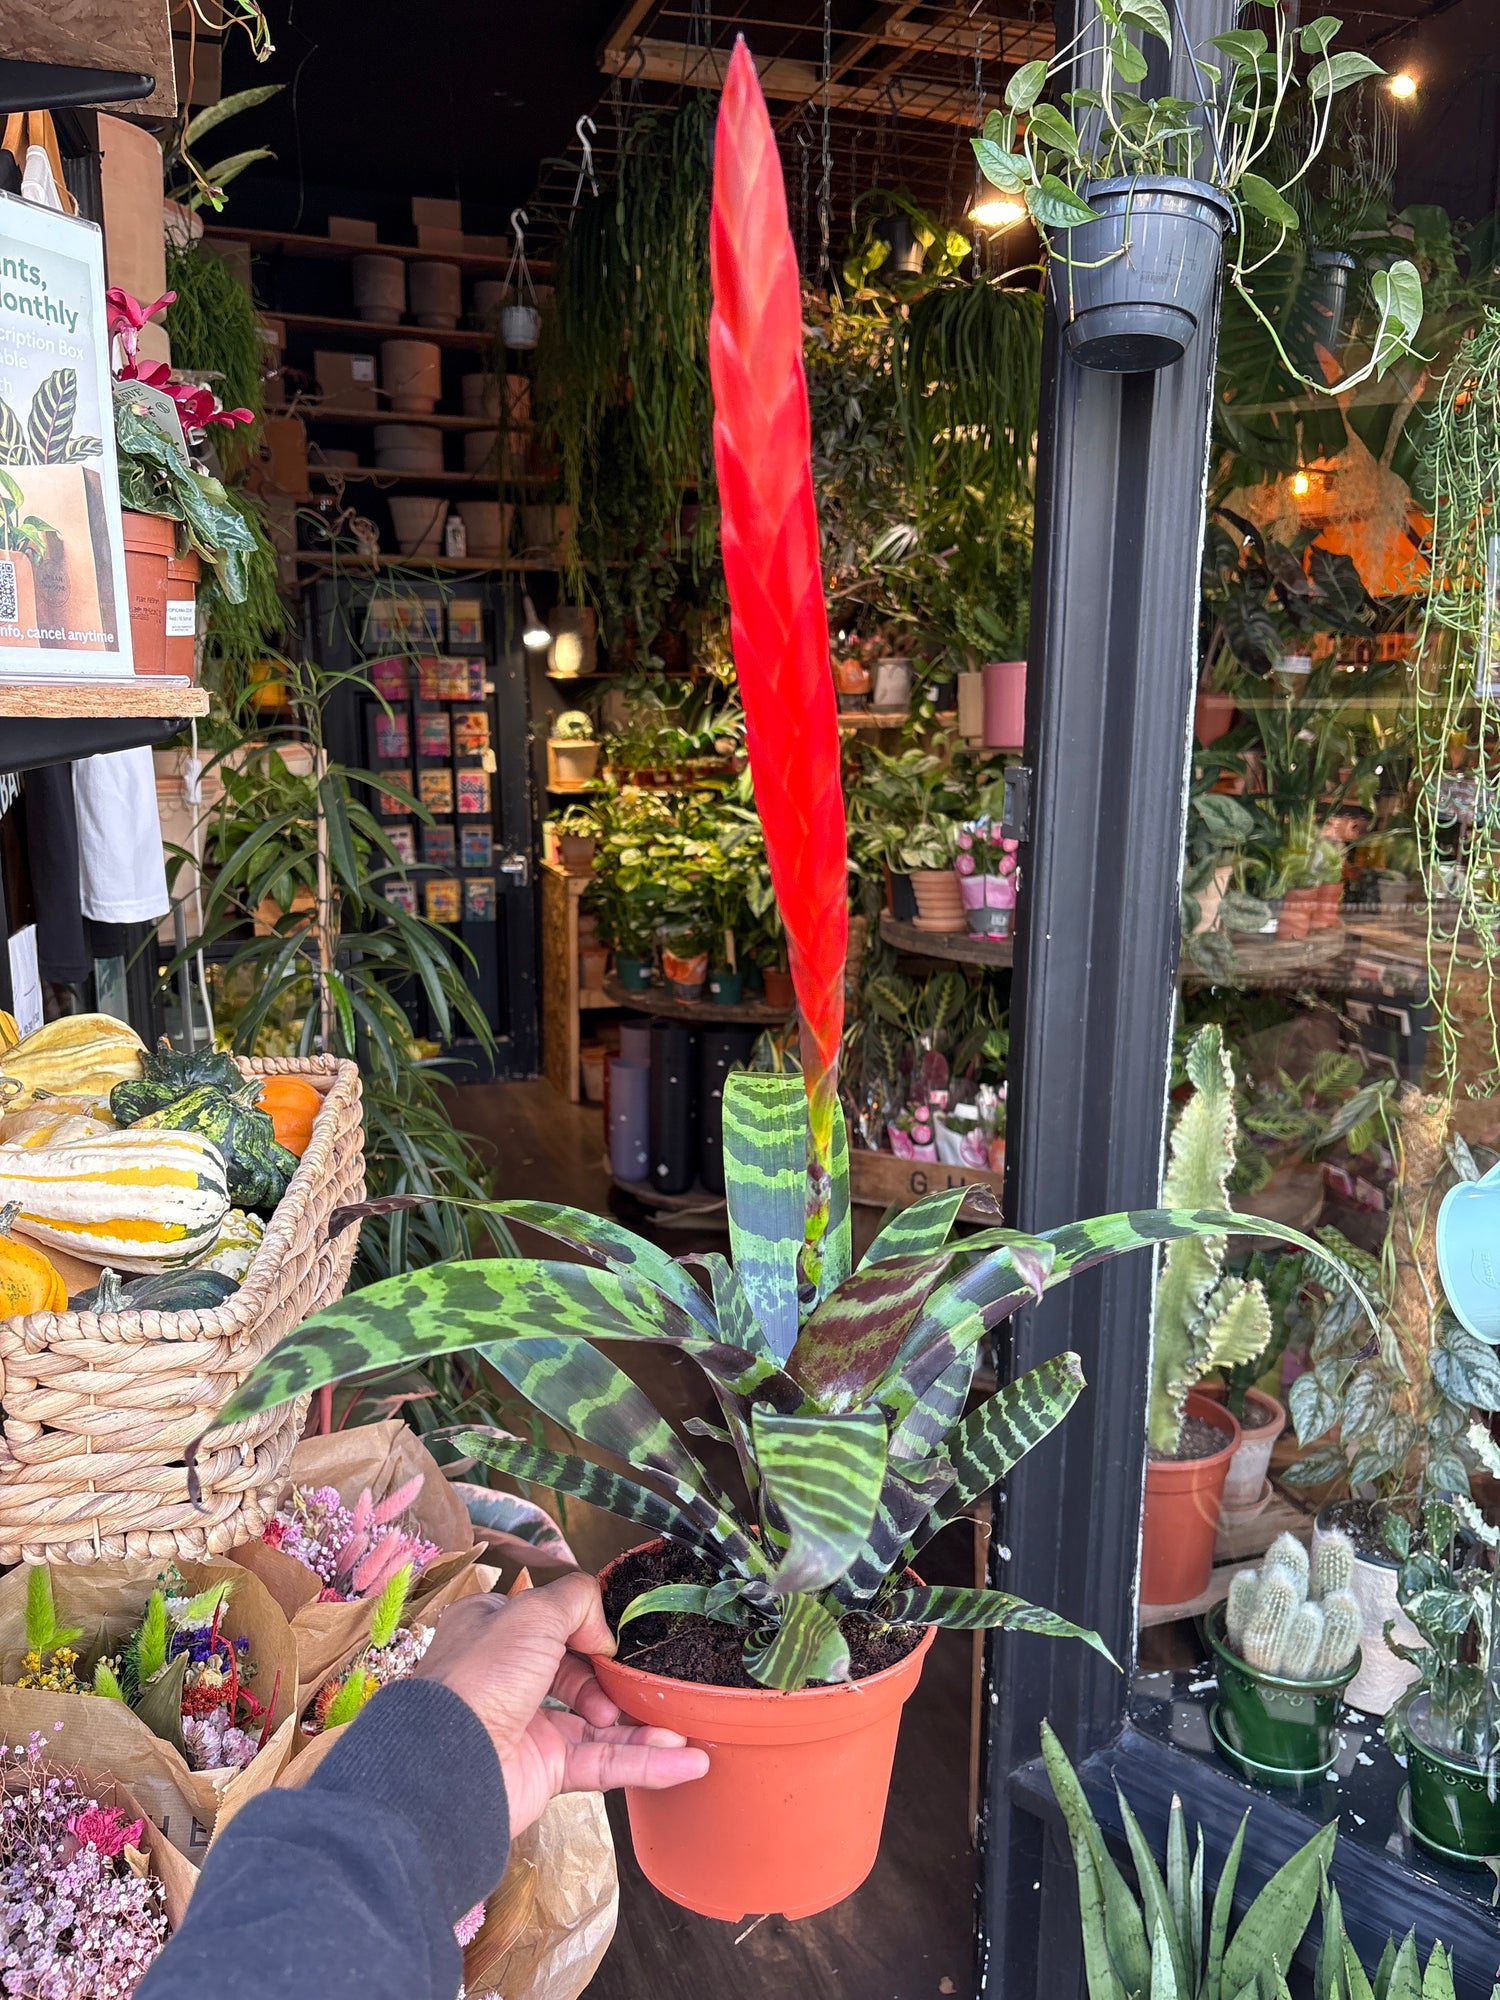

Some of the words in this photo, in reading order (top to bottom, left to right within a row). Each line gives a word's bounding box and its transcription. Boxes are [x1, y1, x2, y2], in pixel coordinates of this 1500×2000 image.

[0, 258, 47, 291] nts,
[0, 283, 79, 334] onthly
[0, 348, 28, 369] ble
[59, 339, 84, 360] Box
[27, 627, 66, 641] cancel
[68, 630, 114, 644] anytime
